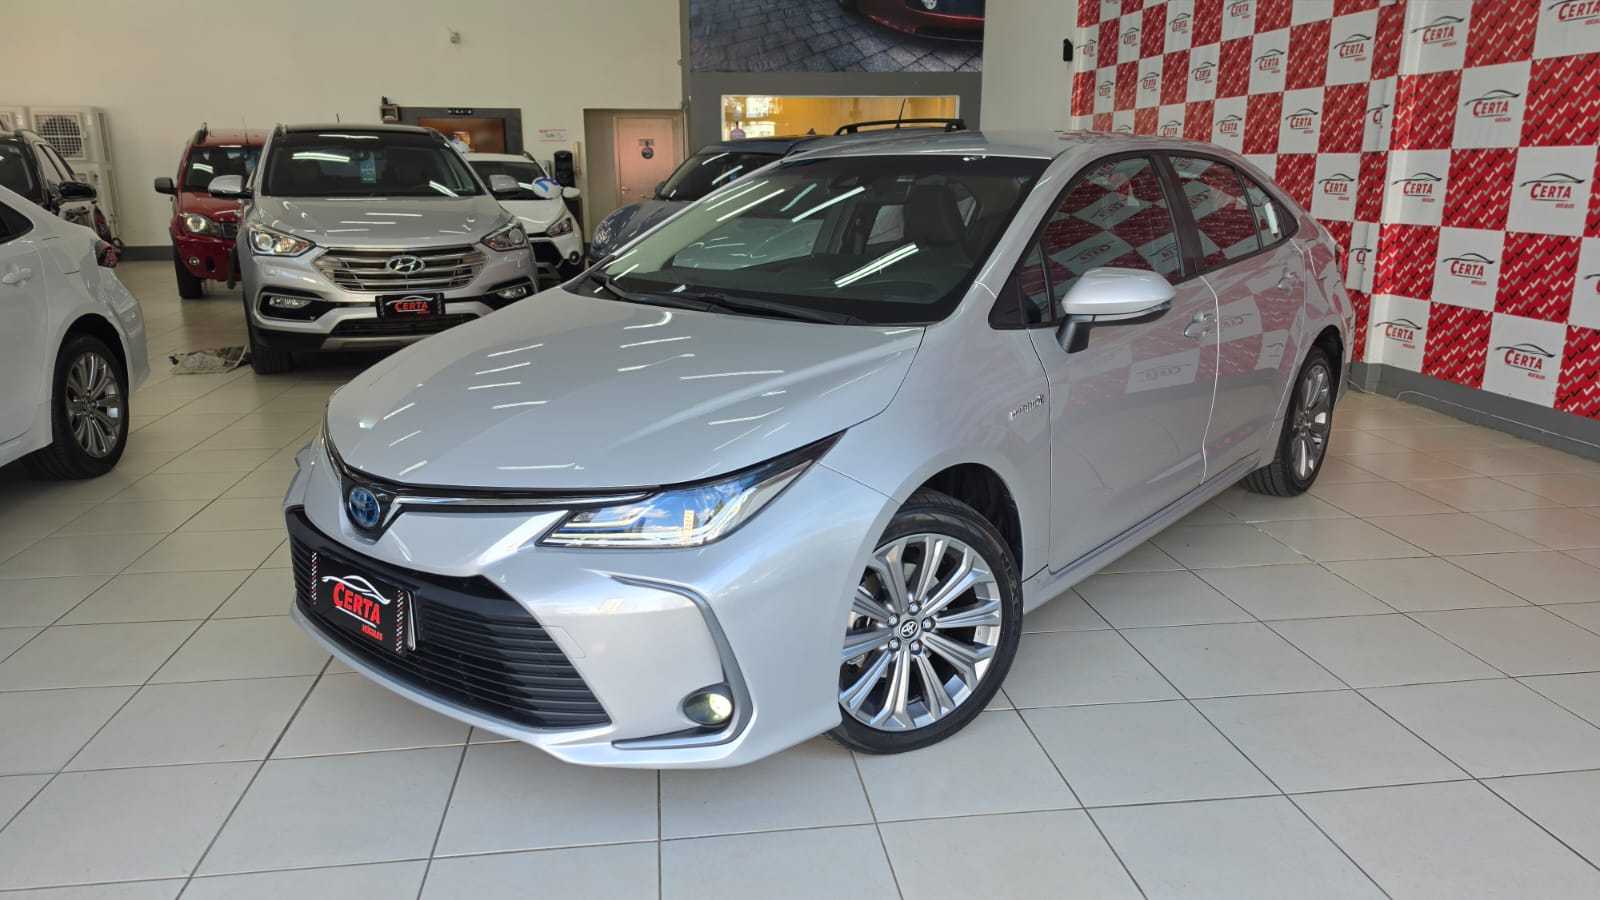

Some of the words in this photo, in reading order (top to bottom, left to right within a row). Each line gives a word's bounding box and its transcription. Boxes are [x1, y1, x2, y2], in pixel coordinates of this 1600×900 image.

[1423, 26, 1455, 42] CERTA
[1340, 43, 1364, 57] CERTA
[1473, 101, 1508, 116] CERTA
[1290, 115, 1312, 129] CERTA
[1324, 181, 1347, 194] CERTA
[1403, 181, 1433, 194] CERTA
[1530, 183, 1571, 199] CERTA
[1451, 261, 1484, 276] CERTA
[395, 301, 428, 312] CERTA
[1385, 325, 1413, 340] CERTA
[1504, 349, 1542, 369] CERTA
[332, 582, 381, 624] CERTA
